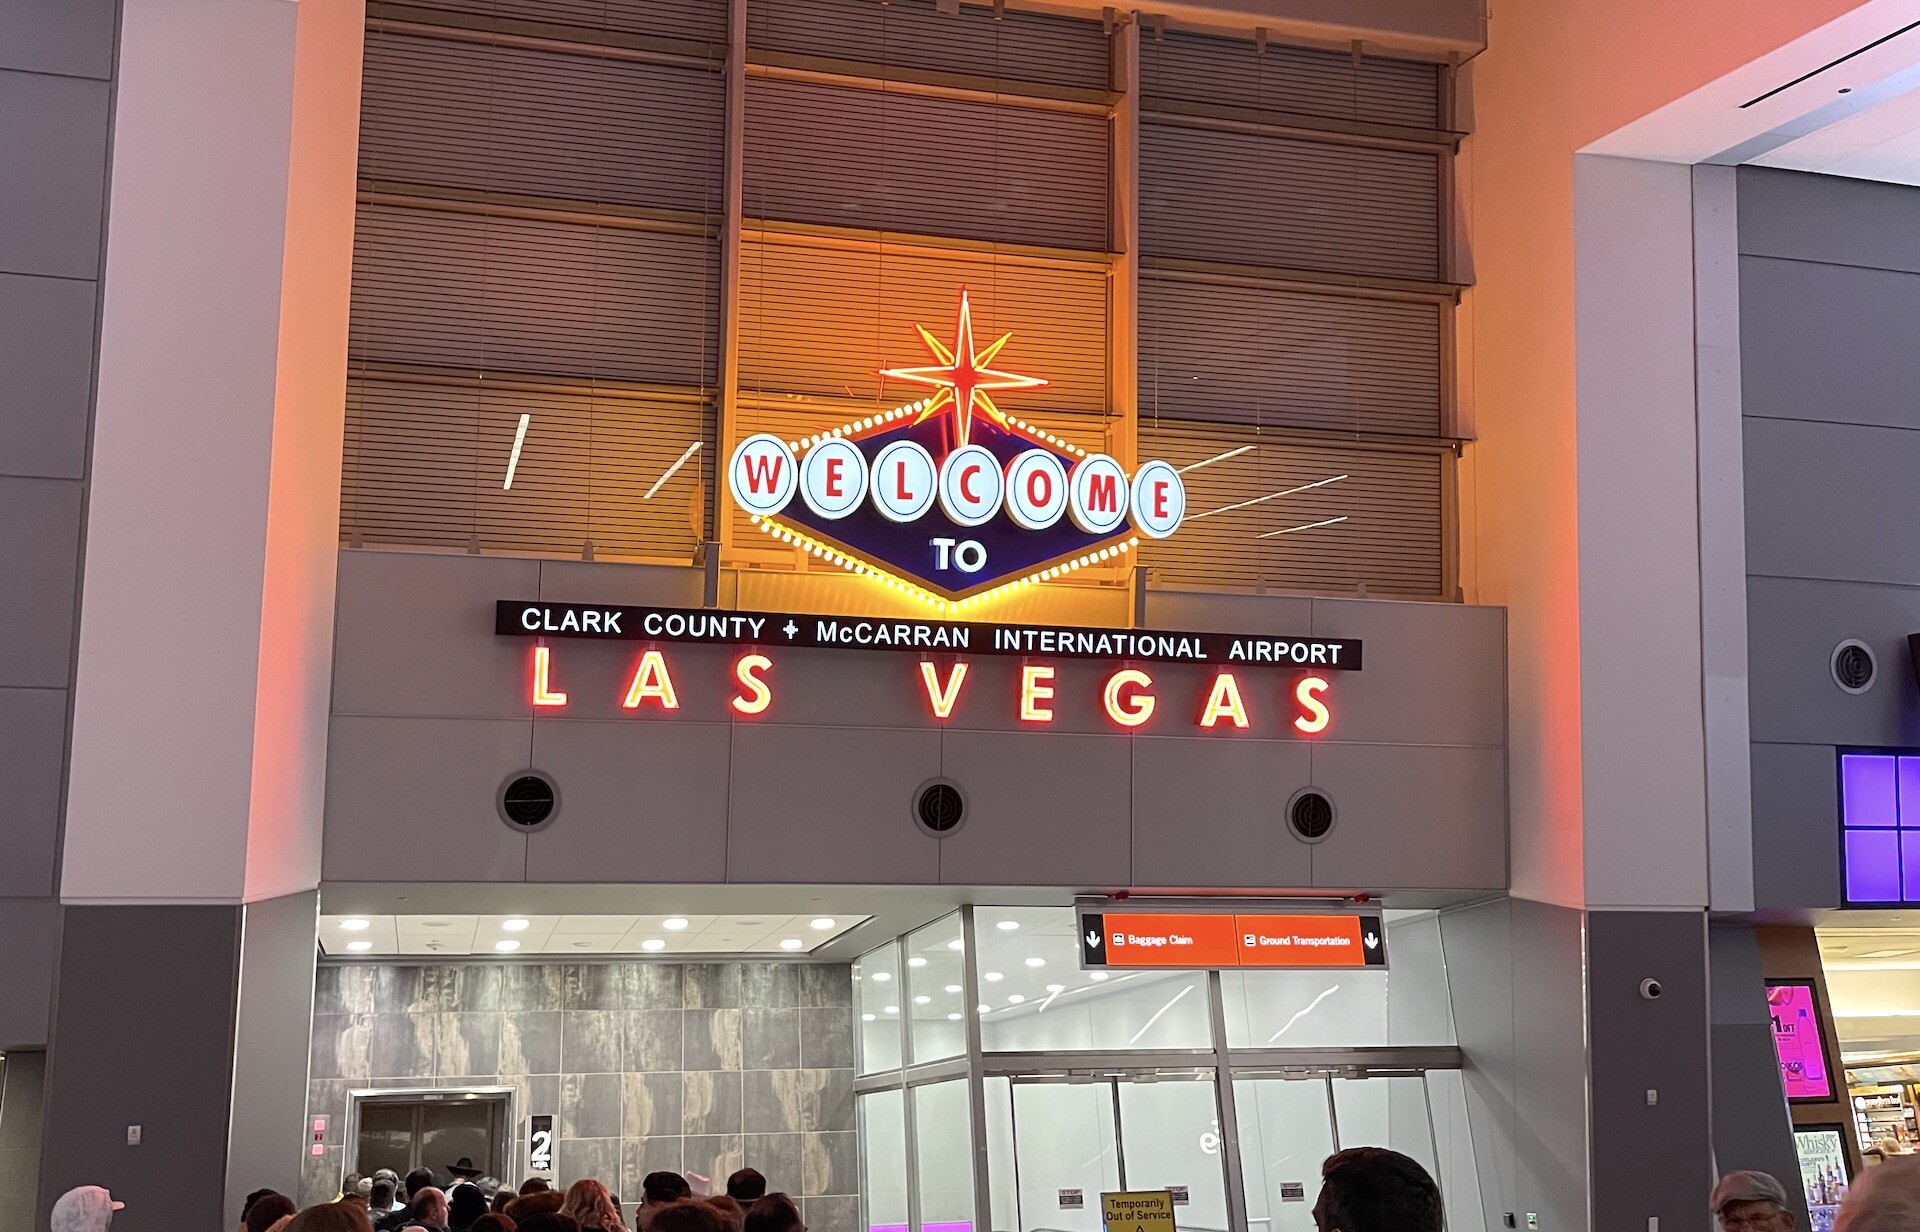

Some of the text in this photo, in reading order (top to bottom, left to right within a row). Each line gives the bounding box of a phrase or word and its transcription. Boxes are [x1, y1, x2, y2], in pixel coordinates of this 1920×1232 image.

[744, 454, 1169, 519] WELCOME
[929, 536, 988, 573] TO
[521, 607, 1343, 665] CLARK COUNTY McCARRAN INTERNATIONAL AIRPORT
[532, 646, 1331, 734] LAS VEGAS
[1128, 934, 1193, 946] Baggage Claim
[1259, 935, 1351, 947] Ground Transportation
[1783, 1023, 1795, 1032] OFF
[531, 1130, 551, 1161] 2
[1110, 1199, 1165, 1210] Temporarily
[1106, 1210, 1171, 1221] Out of Service
